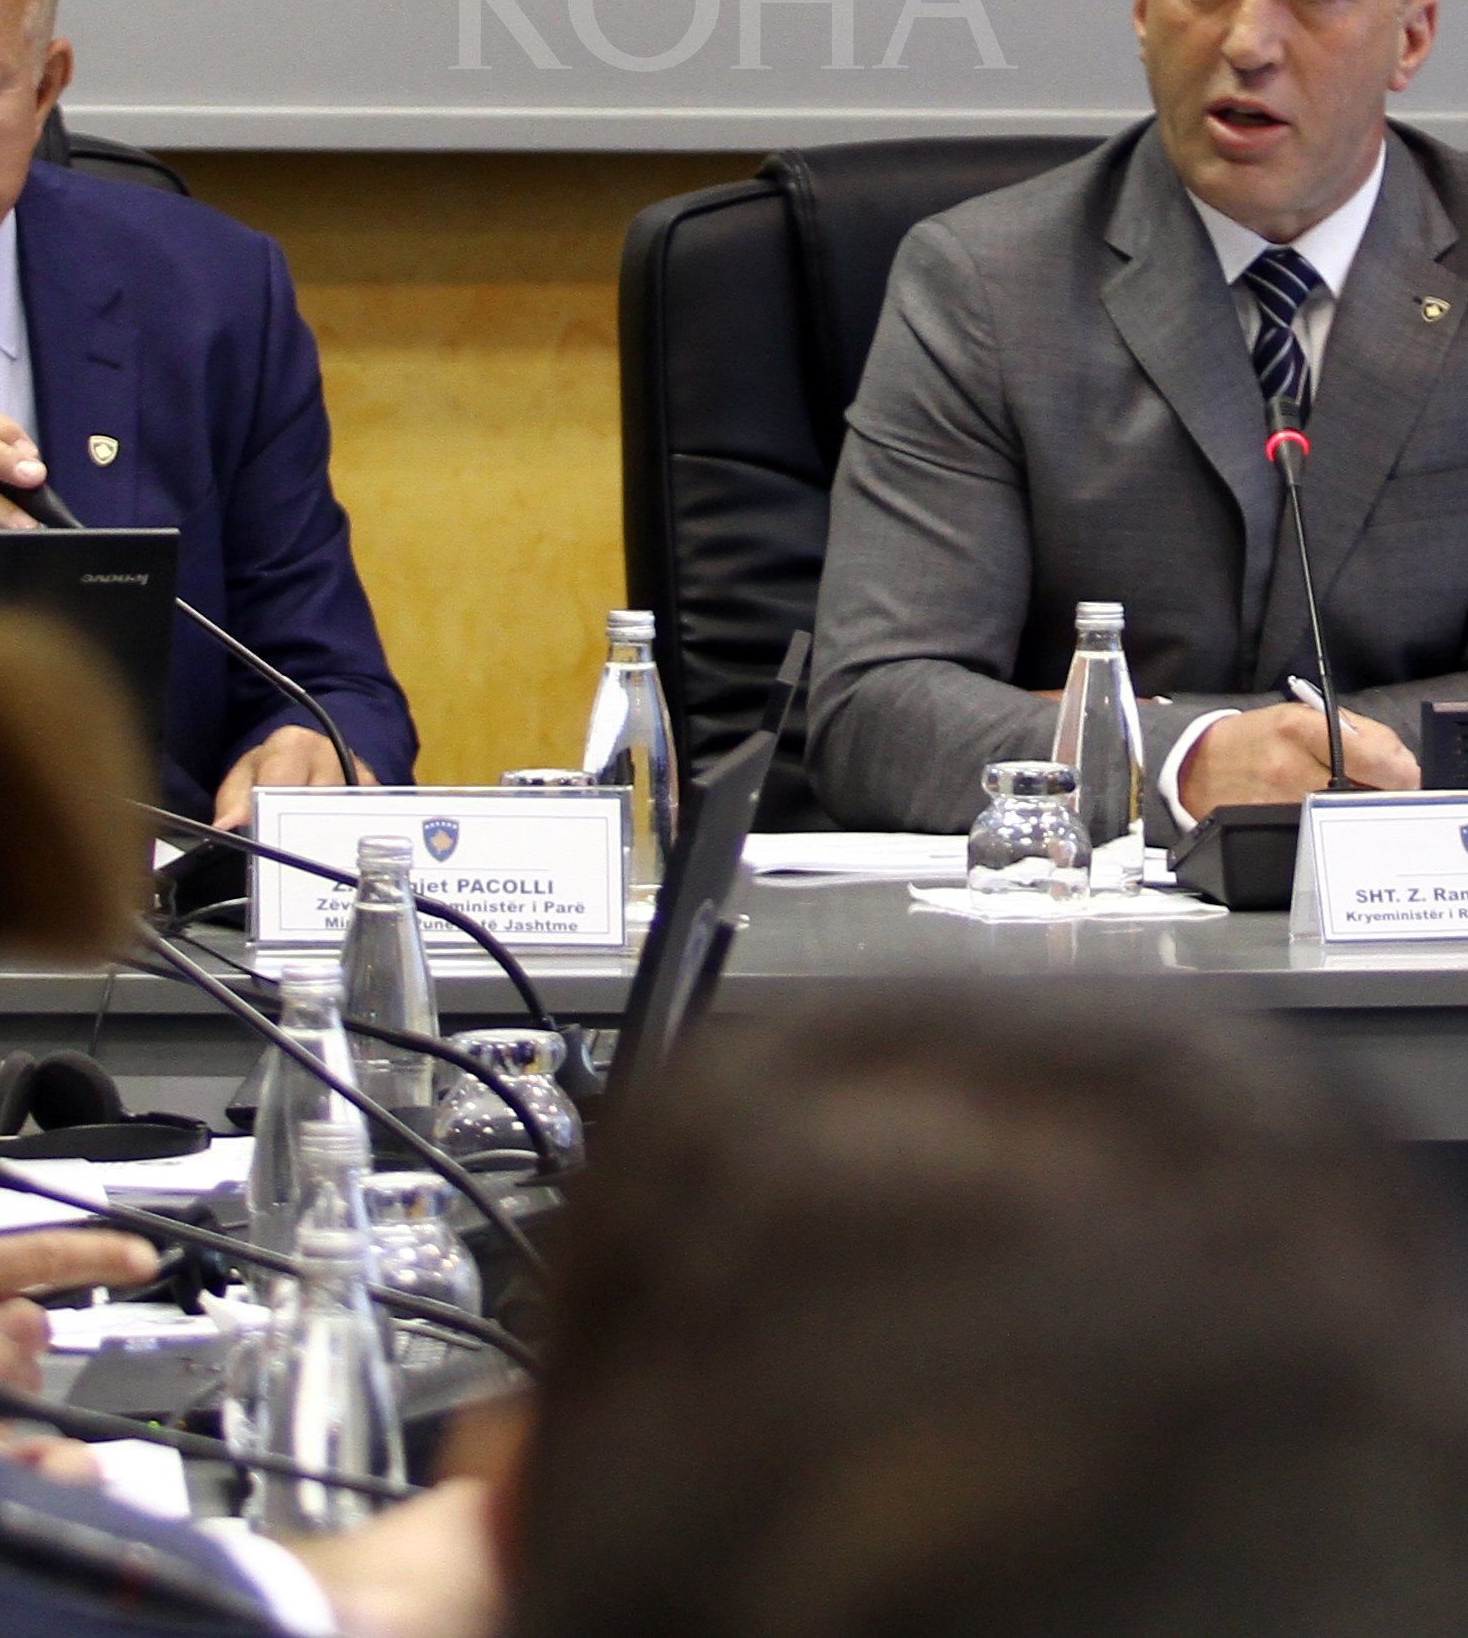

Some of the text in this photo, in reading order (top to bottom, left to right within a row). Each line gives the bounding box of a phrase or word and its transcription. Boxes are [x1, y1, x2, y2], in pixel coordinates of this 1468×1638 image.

[457, 877, 554, 896] PACOLLI
[1355, 888, 1400, 903] SHT.
[1407, 887, 1426, 903] Z.
[544, 900, 585, 914] Parë
[1346, 908, 1444, 924] Kryeministër
[503, 918, 578, 932] Jashtme
